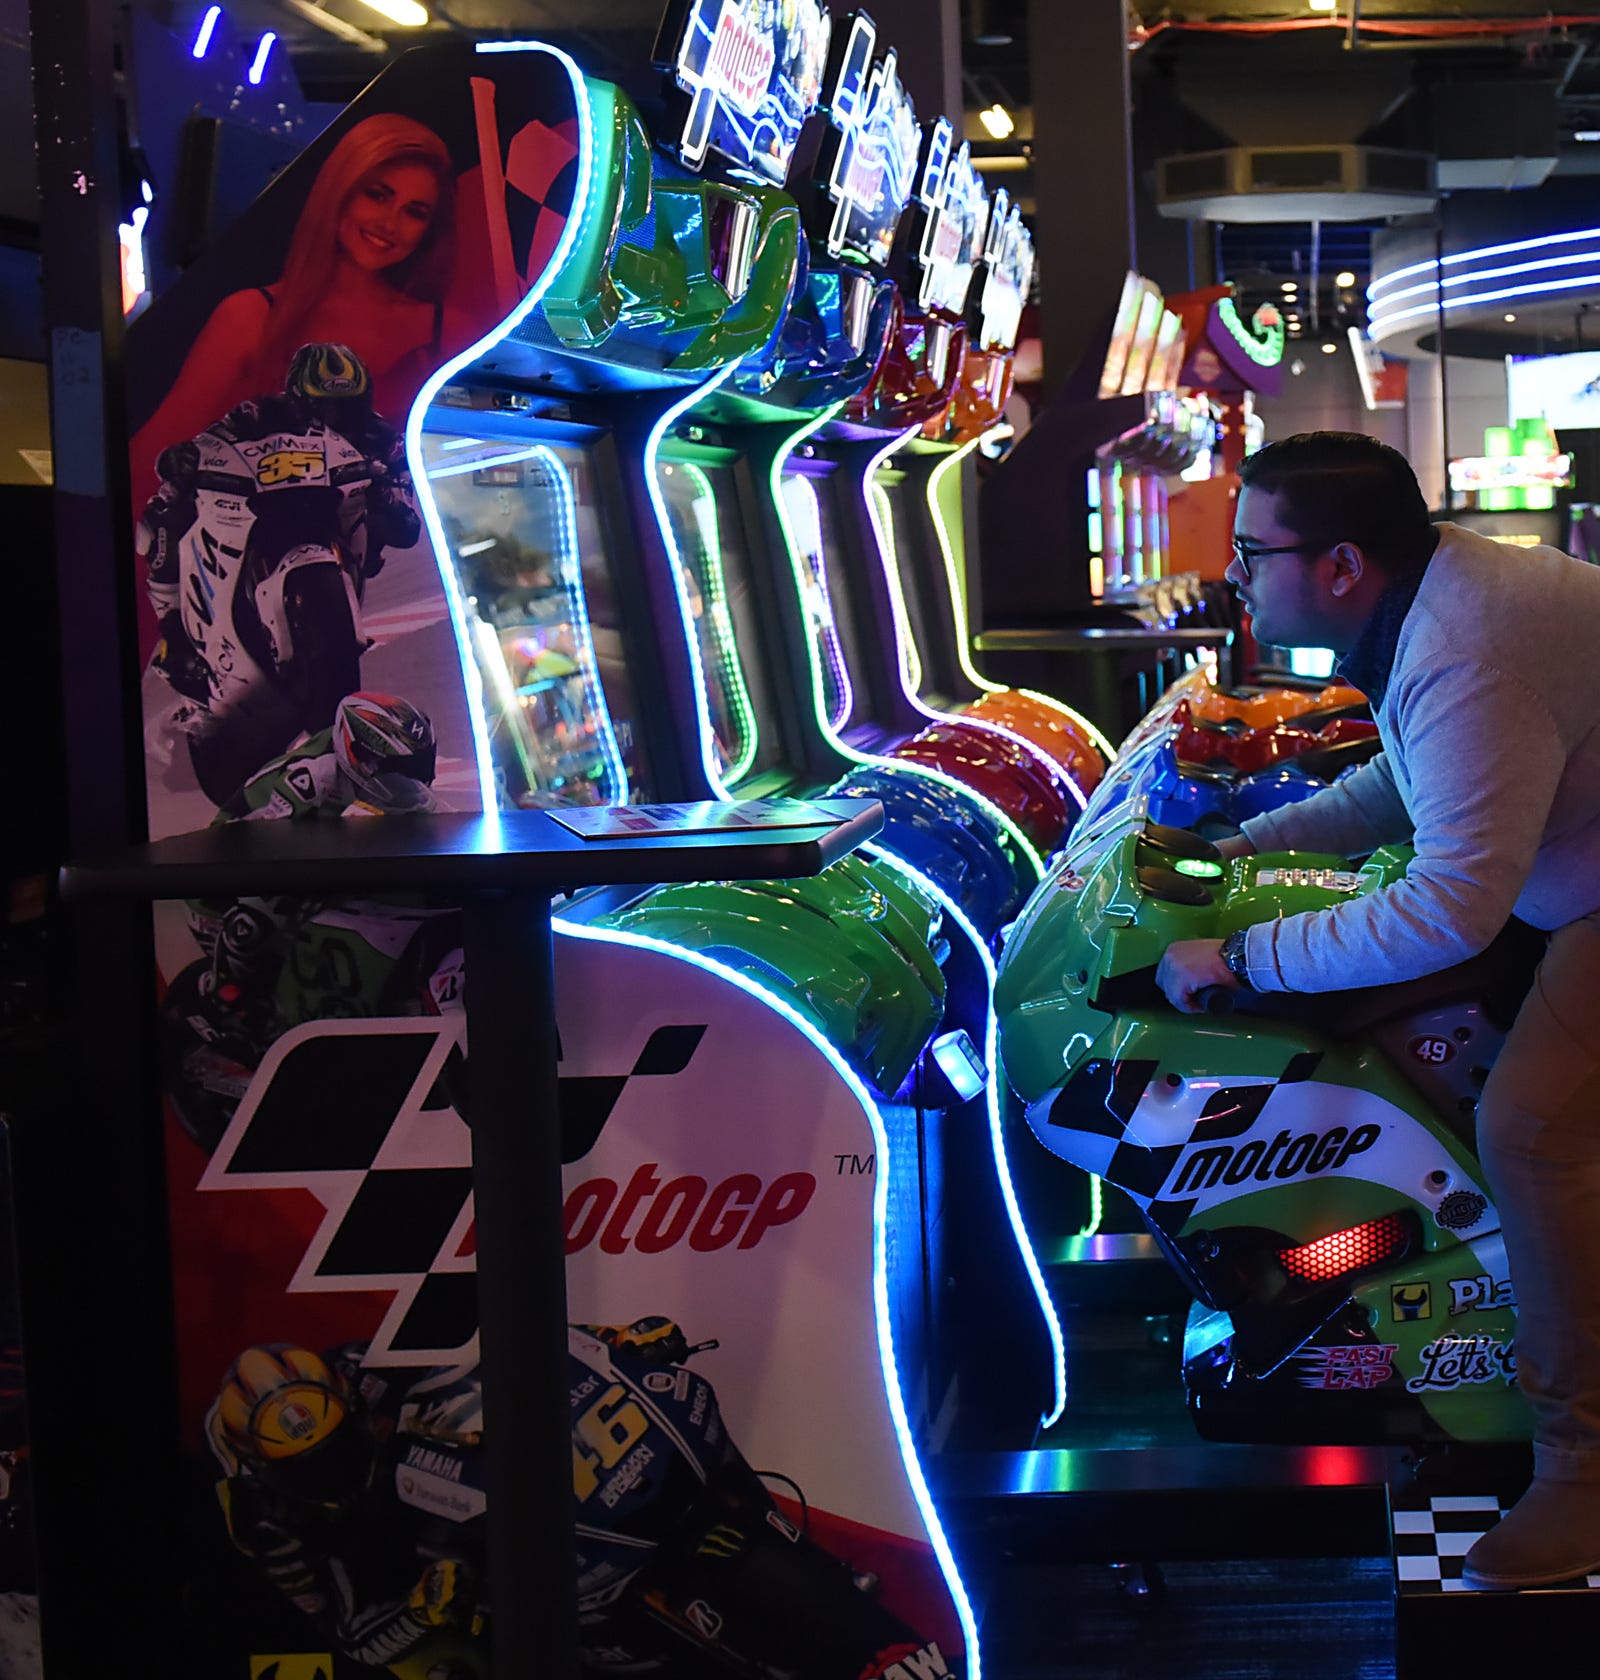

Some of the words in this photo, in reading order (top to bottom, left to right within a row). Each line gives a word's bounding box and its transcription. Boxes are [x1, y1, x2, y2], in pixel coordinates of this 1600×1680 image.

[257, 451, 326, 486] 35
[1416, 1039, 1448, 1061] 49
[562, 1163, 817, 1256] otoGP
[833, 1154, 875, 1175] TM
[1448, 1275, 1520, 1316] Pla
[1327, 1345, 1400, 1365] FAST
[1406, 1333, 1495, 1392] Let's
[569, 1375, 601, 1408] star
[1322, 1365, 1392, 1389] LAP
[405, 1445, 463, 1482] YAMAHA
[866, 1640, 949, 1680] AW
